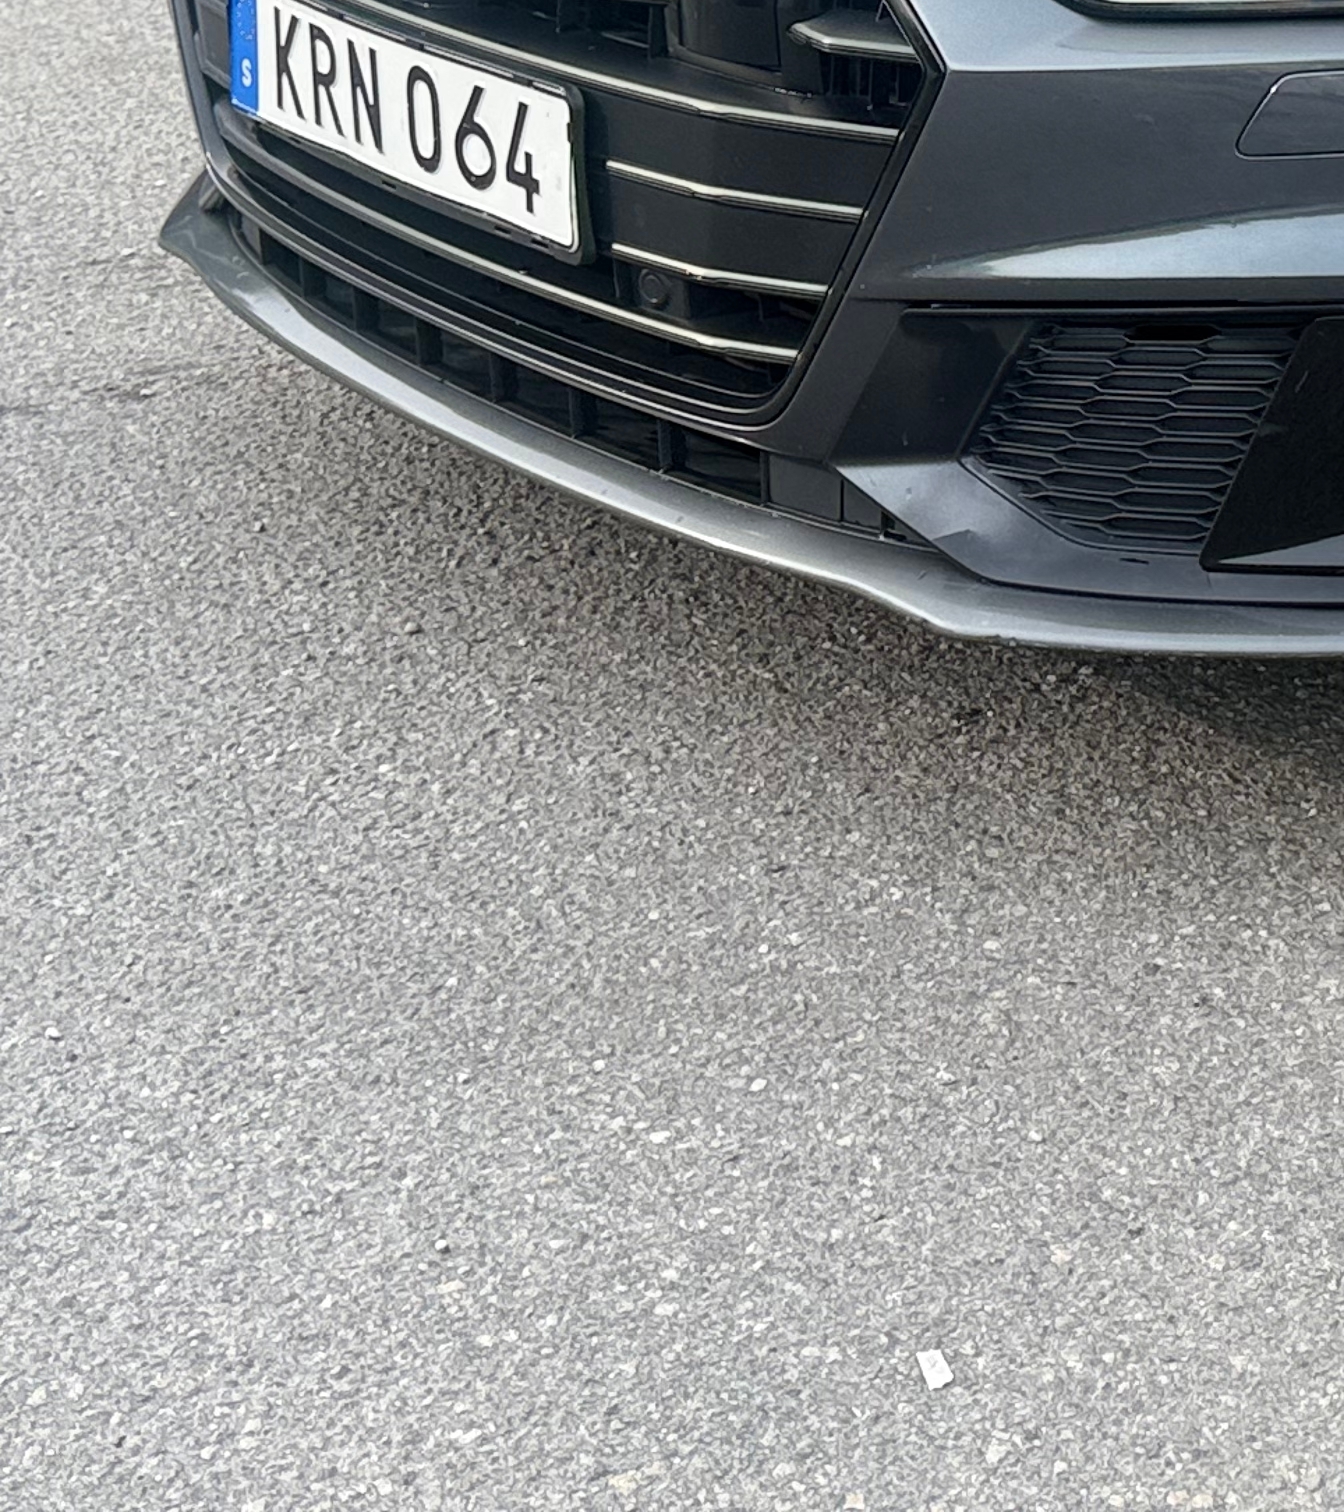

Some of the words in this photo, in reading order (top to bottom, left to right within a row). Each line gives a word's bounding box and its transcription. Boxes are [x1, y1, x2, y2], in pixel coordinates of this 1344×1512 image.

[241, 57, 252, 87] S
[273, 5, 384, 155] KRN
[406, 64, 541, 215] 064
